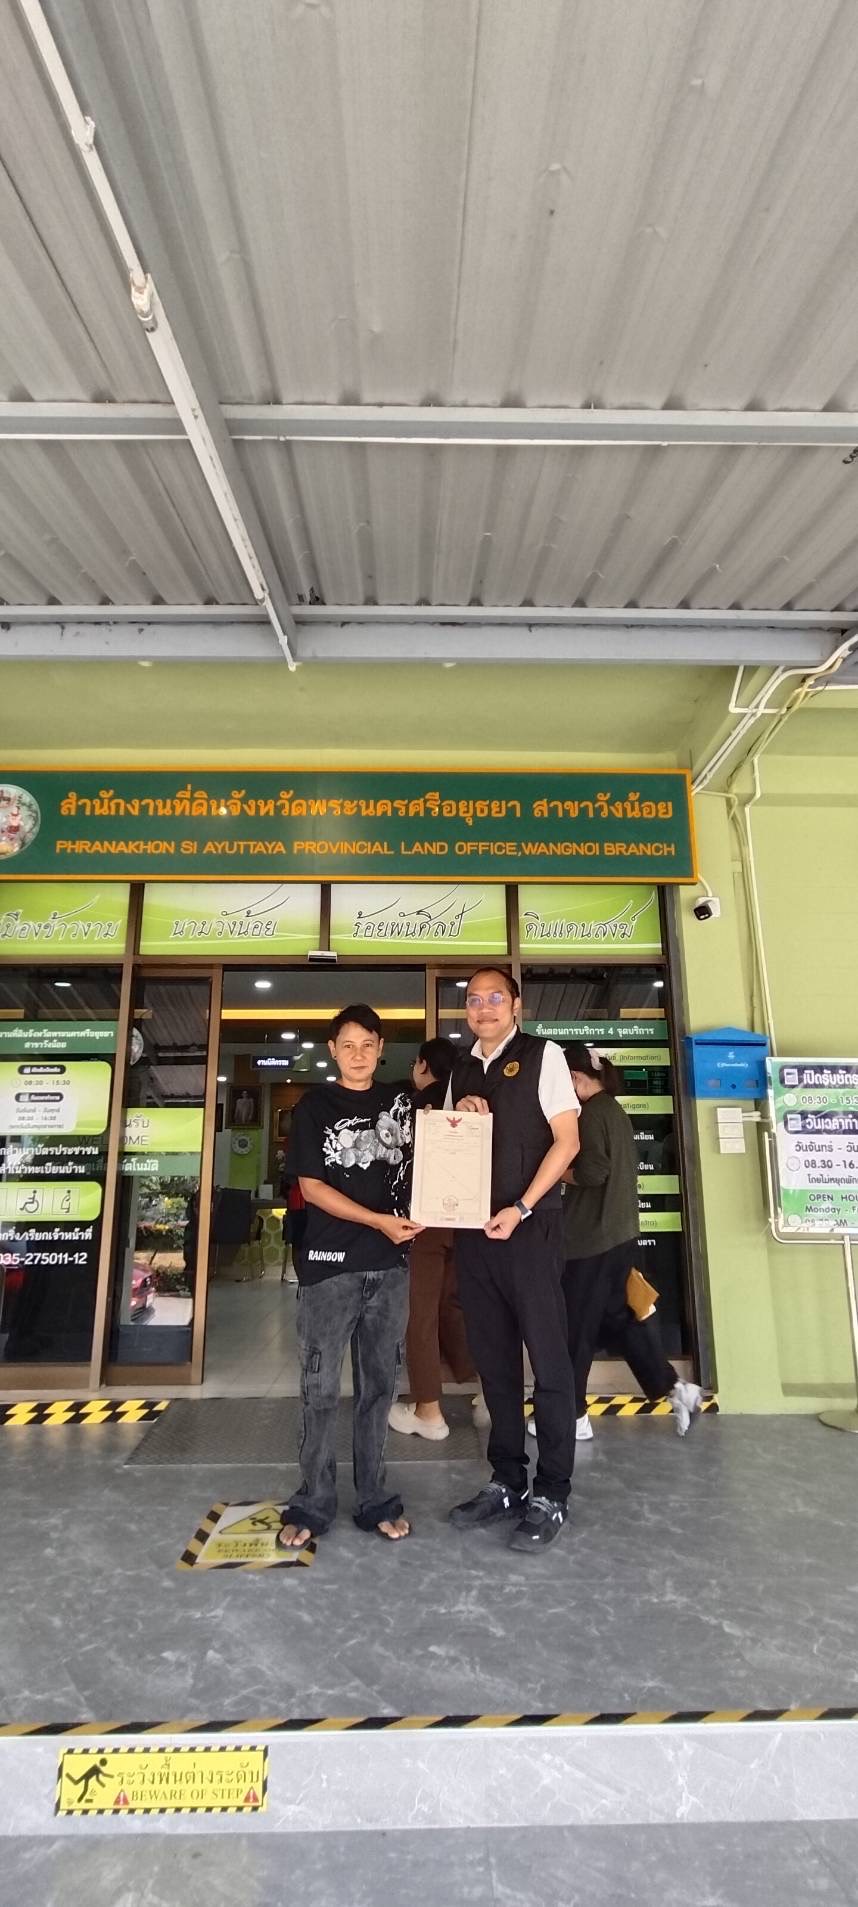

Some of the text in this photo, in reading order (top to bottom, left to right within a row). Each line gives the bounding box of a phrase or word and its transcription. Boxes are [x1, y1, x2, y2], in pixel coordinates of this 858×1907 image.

[60, 785, 673, 825] สำนักงานที่ดินจังหวัดพระนครศรีอยุธยา สาขาวังน้อย
[56, 840, 175, 854] PHRANAKHON
[180, 840, 197, 854] SI
[203, 841, 286, 855] AYUTTAYA
[293, 841, 394, 855] PROVINCIAL
[401, 842, 448, 855] LAND
[604, 843, 675, 856] BRANCH
[0, 896, 121, 940] มืองข้าวงาม
[171, 890, 289, 938] นามวังน้อย
[353, 888, 483, 938] ร้อยพันศิลป์
[524, 893, 654, 939] ดินแดนสงฆ์
[536, 1024, 655, 1037] ขั้นตอนการบริการ 4 จุดบริการ
[802, 1096, 828, 1105] 08:30
[795, 1141, 834, 1152] วันจันทร์
[804, 1160, 833, 1169] 08.30
[809, 1194, 833, 1202] OPEN
[805, 1206, 841, 1215] Monday
[308, 1250, 346, 1262] RAINBOW
[117, 1756, 259, 1785] ระวังพื้นต่างระดับ
[131, 1788, 243, 1801] BEWARE OF STEP
